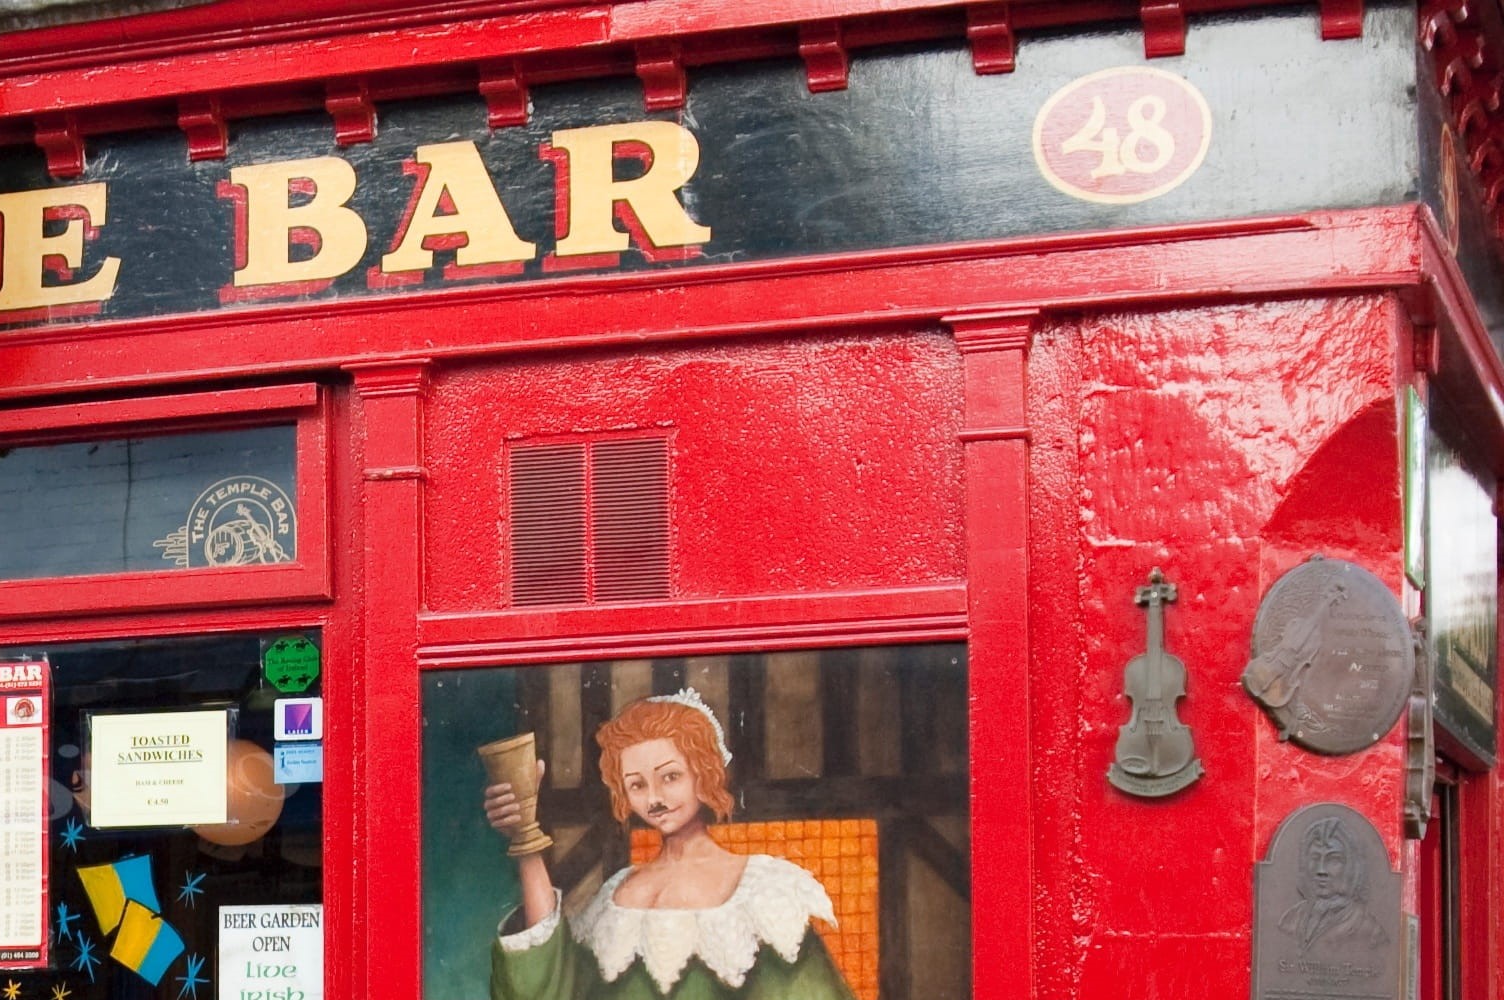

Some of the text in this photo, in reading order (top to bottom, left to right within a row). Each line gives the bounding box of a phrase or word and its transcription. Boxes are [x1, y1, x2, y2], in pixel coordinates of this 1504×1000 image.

[1060, 94, 1176, 179] 48
[226, 118, 713, 290] BAR
[191, 482, 289, 544] THE TEMPLE BAR
[130, 734, 191, 748] TOASTED
[117, 749, 204, 764] SANDWICHES
[158, 778, 185, 786] CHEESE
[223, 911, 321, 929] BEER GARDEN
[252, 935, 292, 952] OPEN
[246, 961, 297, 978] Live
